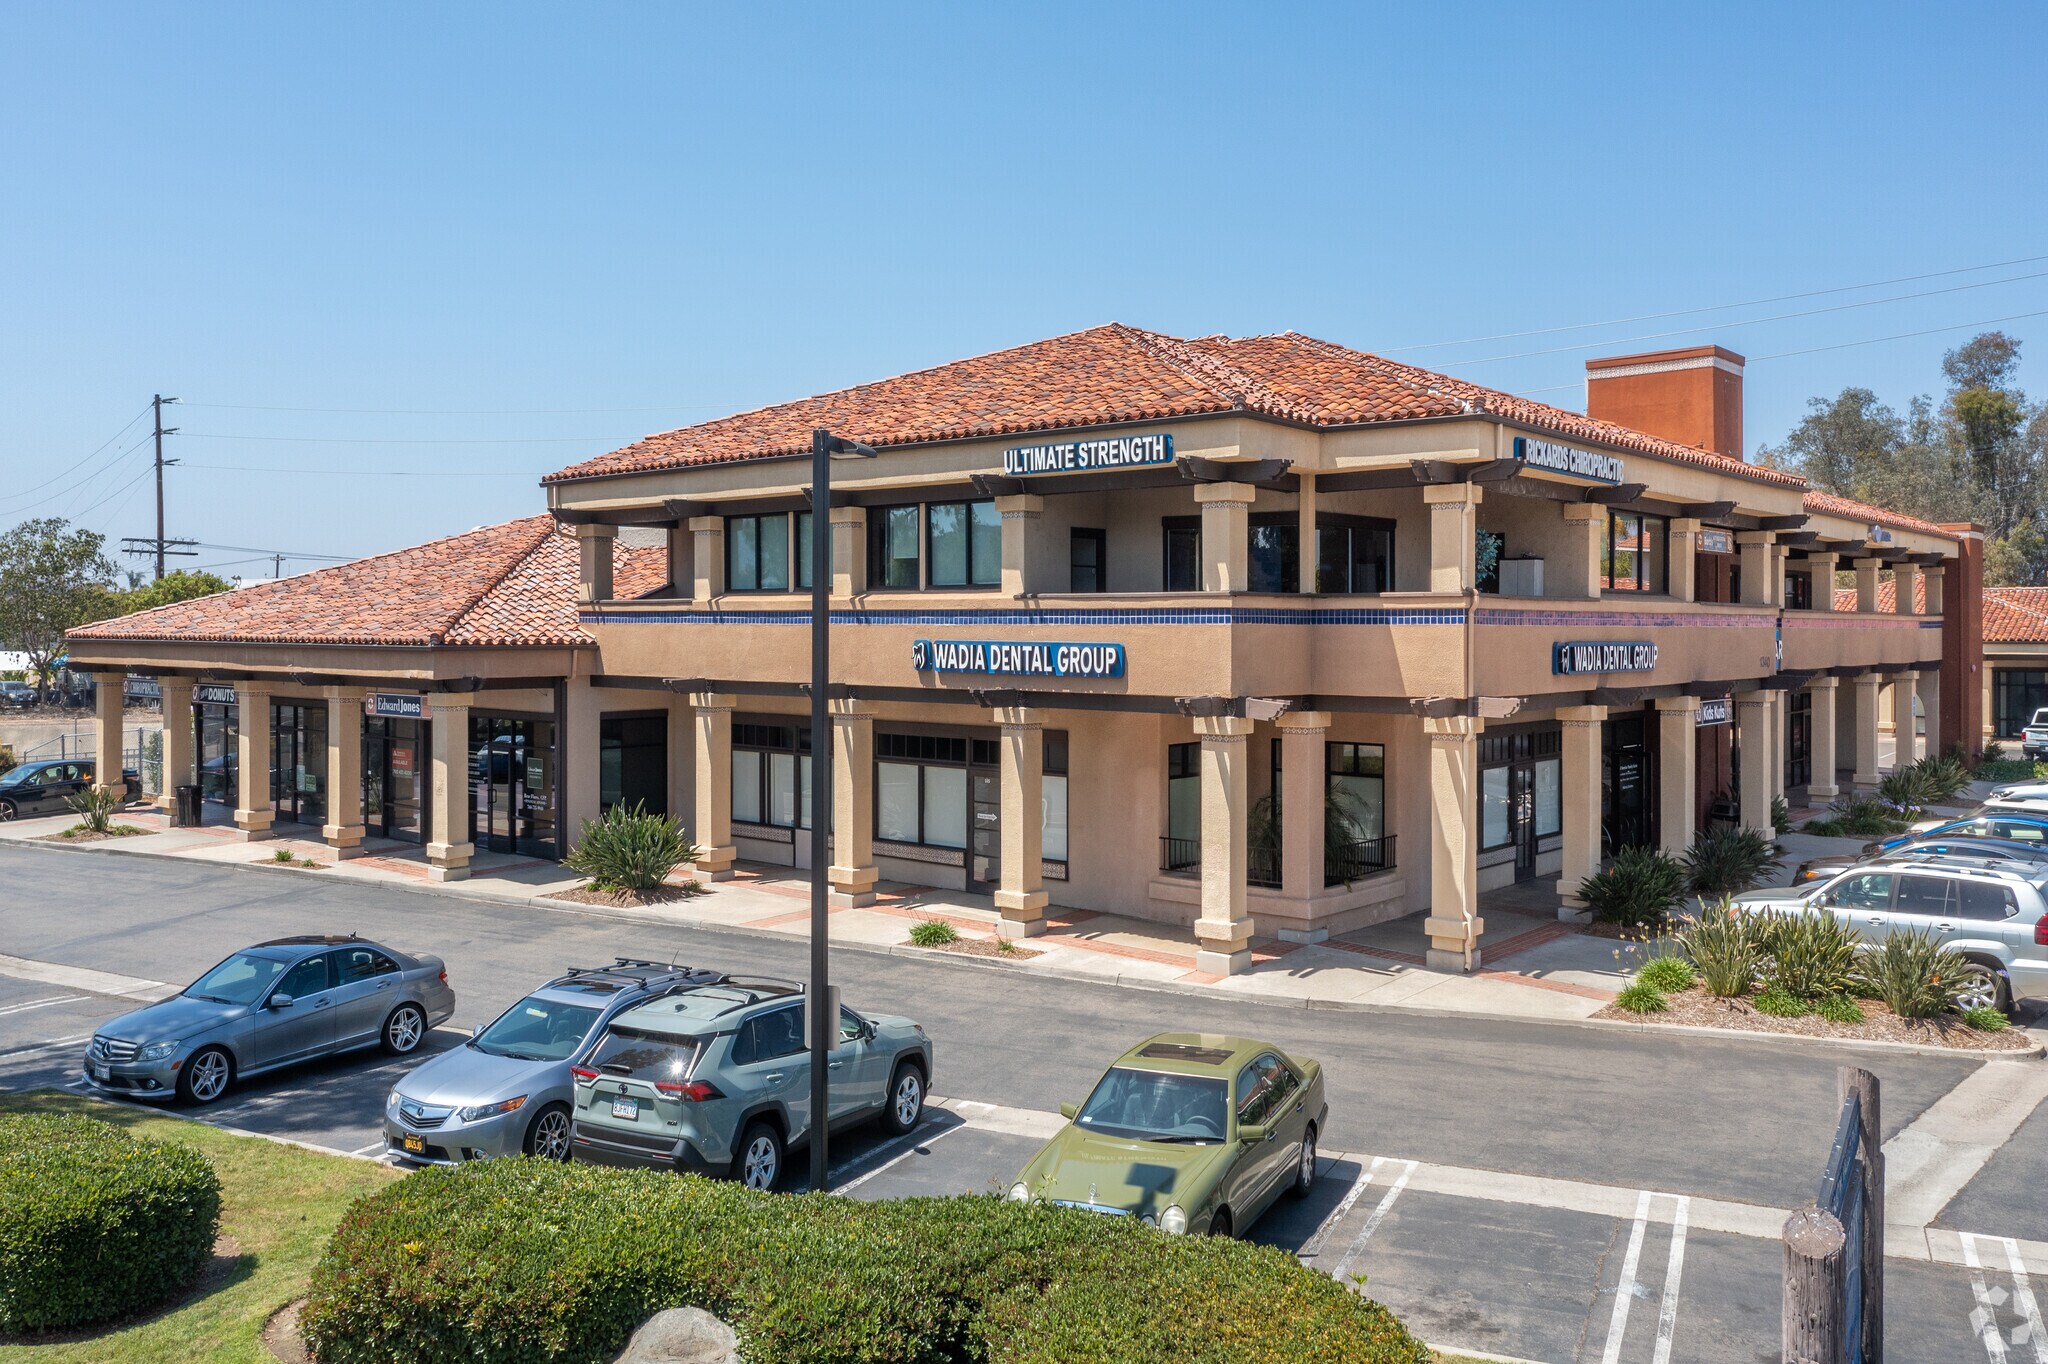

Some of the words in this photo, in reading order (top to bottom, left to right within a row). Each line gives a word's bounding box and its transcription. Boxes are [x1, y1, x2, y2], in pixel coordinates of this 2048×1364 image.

[1003, 444, 1075, 474] ULTIMATE
[1078, 435, 1164, 467] STRENGTH
[1526, 439, 1568, 471] RICKARDS
[1569, 448, 1624, 480] CHIROPRACTIC
[933, 643, 985, 670] WADIA
[990, 645, 1052, 672] DENTAL
[1057, 646, 1117, 674] GROUP
[1574, 646, 1602, 672] WADIA
[1604, 645, 1632, 670] DENTAL
[1634, 645, 1658, 669] GROUP
[208, 688, 235, 703] DONUTS
